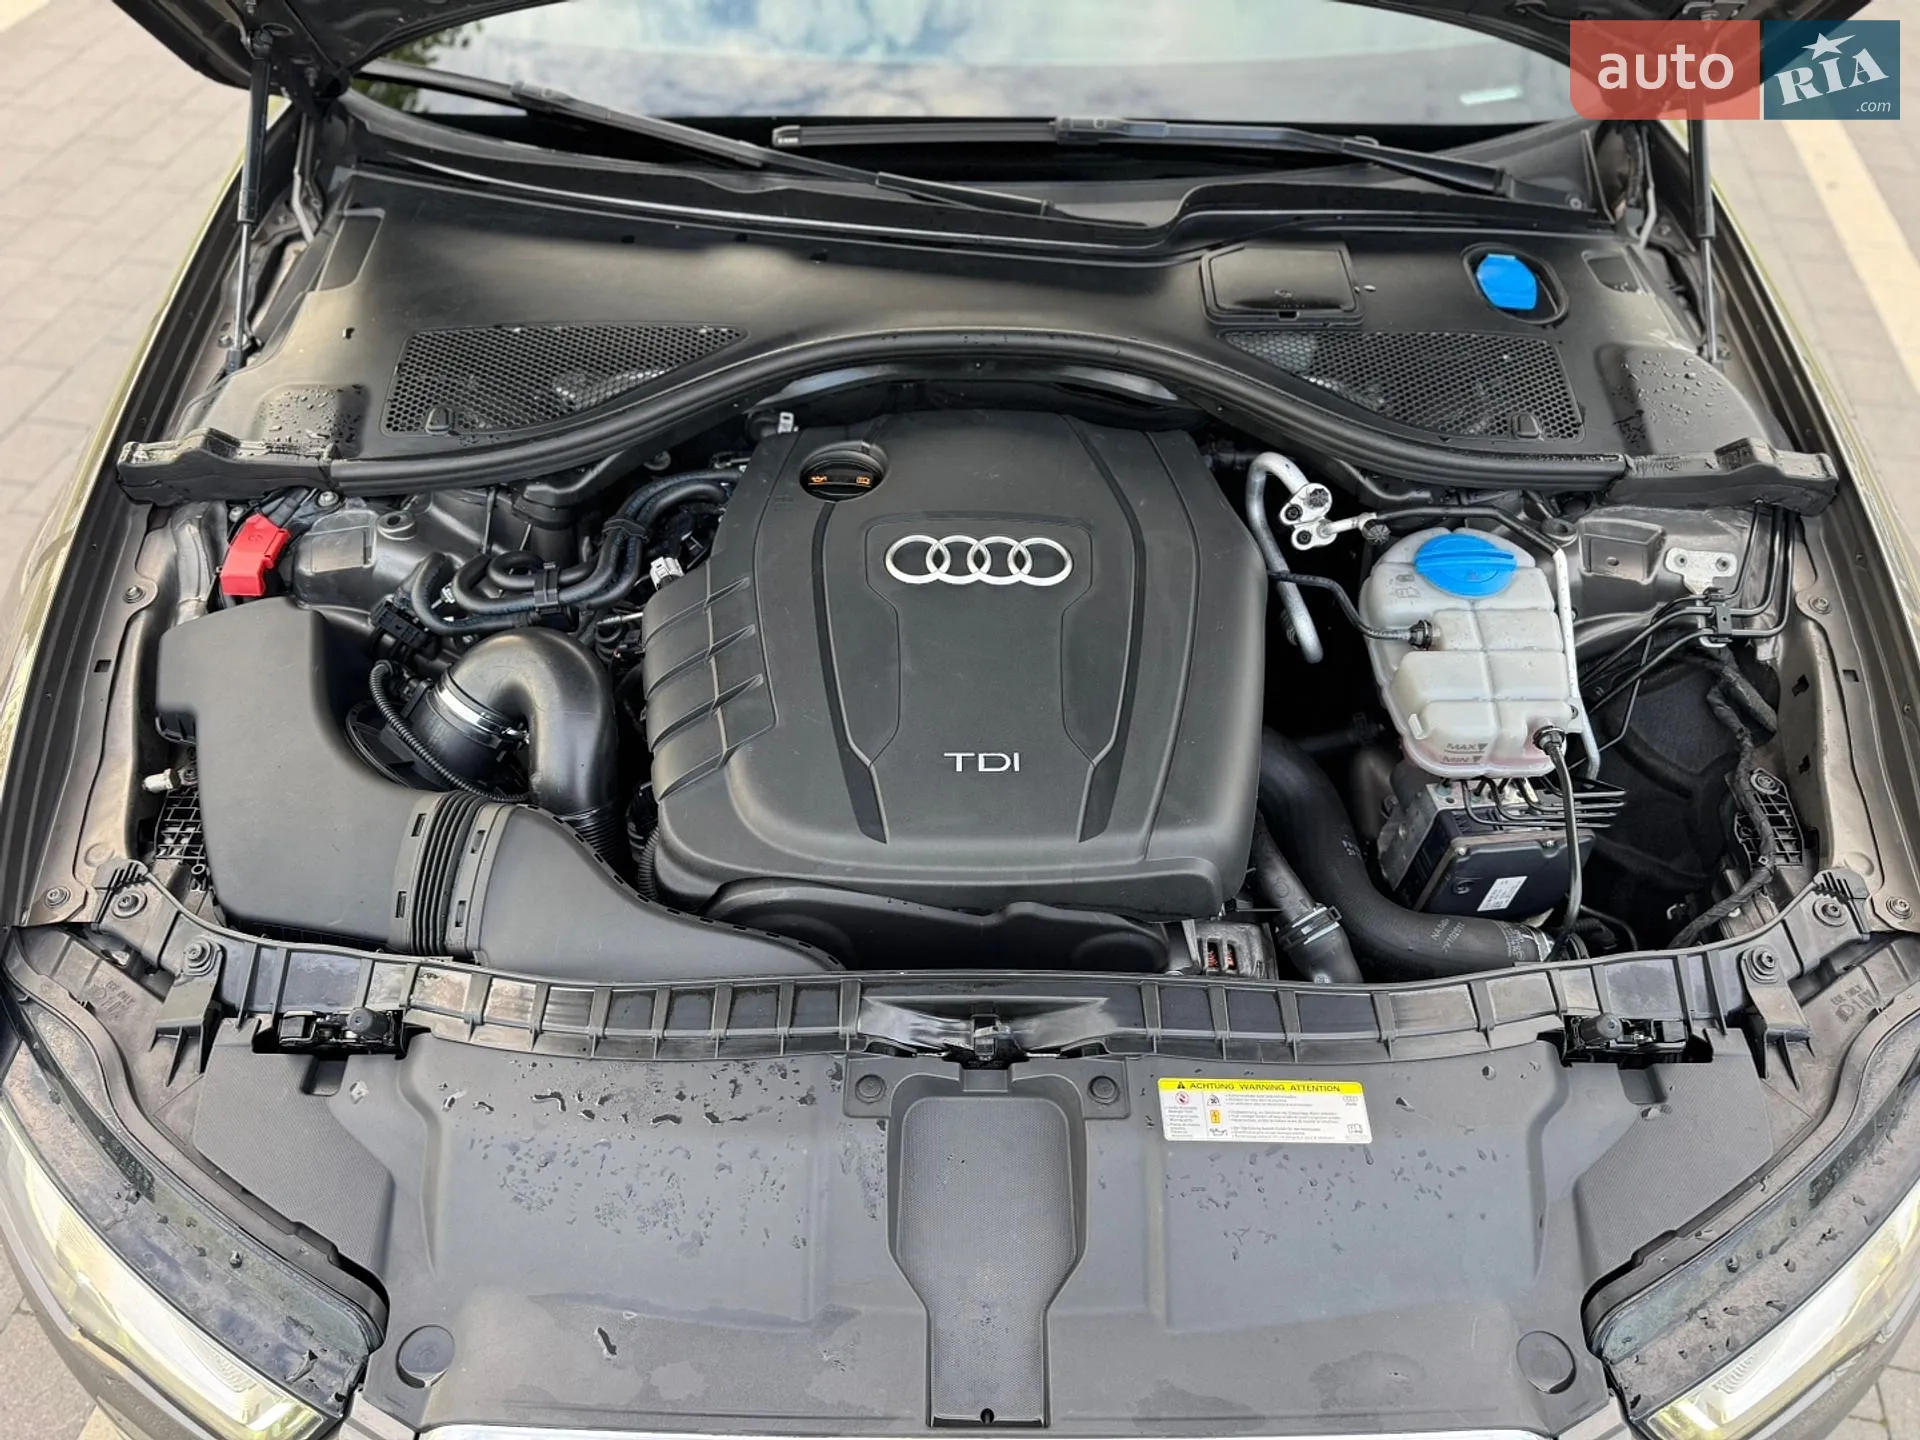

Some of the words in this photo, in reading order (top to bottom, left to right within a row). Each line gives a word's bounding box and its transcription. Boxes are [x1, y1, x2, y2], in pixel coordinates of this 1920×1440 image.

[943, 752, 1020, 772] TDI
[1189, 1082, 1235, 1091] ACHTUNG
[1240, 1083, 1286, 1092] WARNING
[1289, 1084, 1341, 1093] ATTENTION
